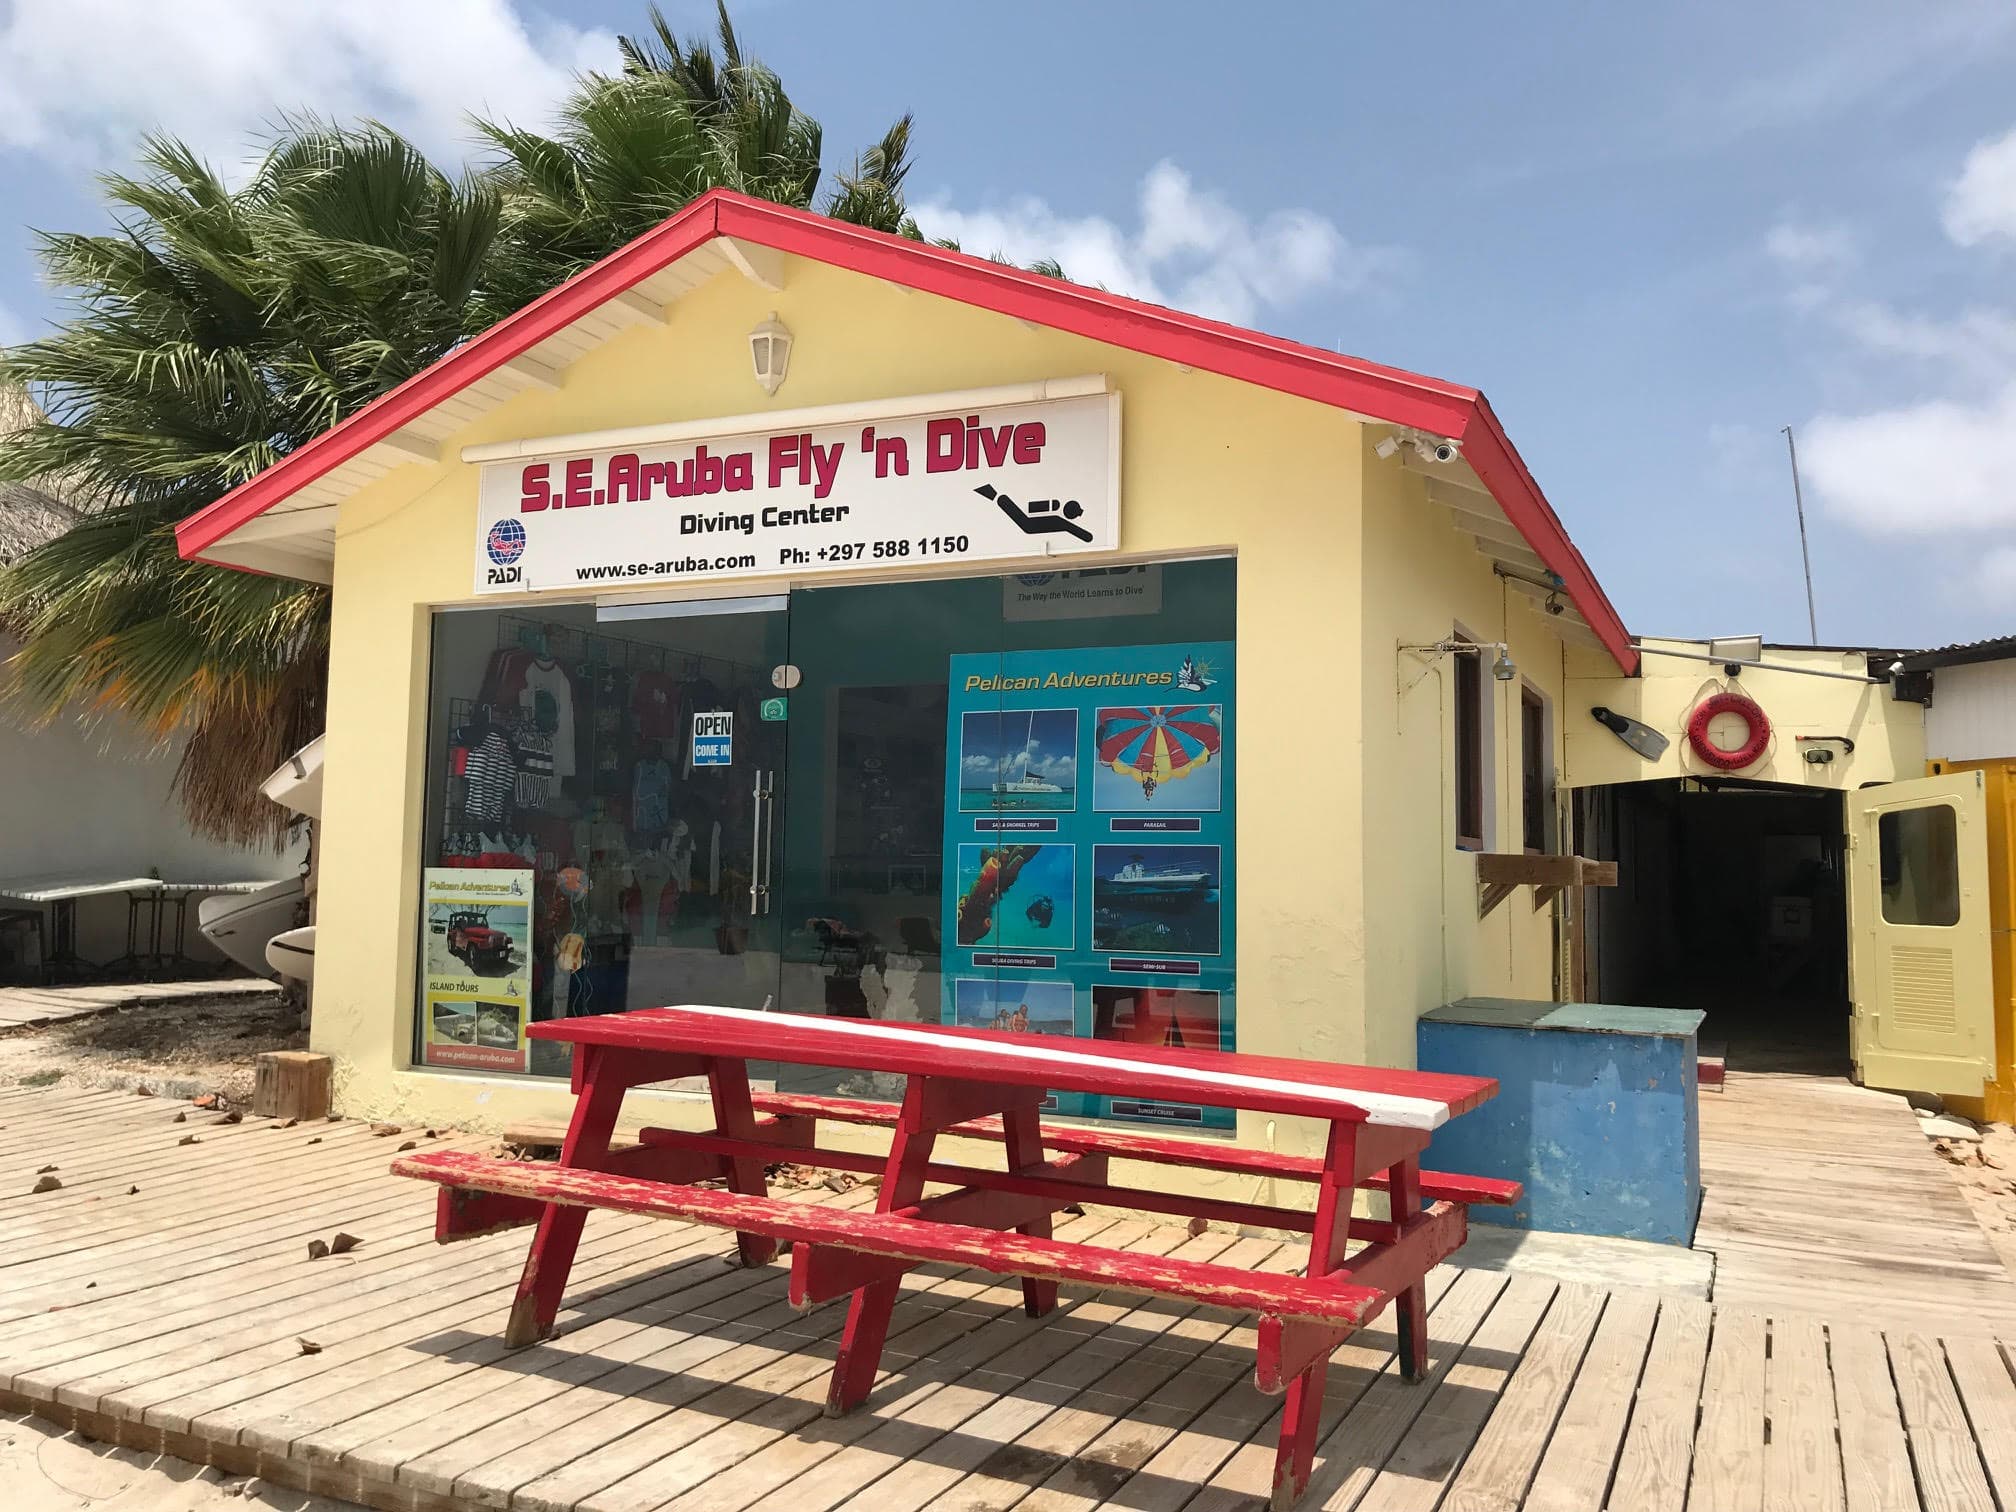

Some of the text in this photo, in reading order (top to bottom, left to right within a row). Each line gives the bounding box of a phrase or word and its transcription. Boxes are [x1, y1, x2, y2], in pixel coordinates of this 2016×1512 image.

[520, 445, 754, 513] S.E.Aruba
[768, 433, 846, 499] Fly
[926, 415, 1047, 474] Dive
[680, 503, 850, 535] Diving Center
[779, 535, 969, 565] Ph: +297 588 1150
[487, 566, 522, 585] PADI
[576, 553, 757, 581] www.se-aruba.com
[1032, 592, 1049, 602] Way
[1049, 590, 1062, 601] the
[1062, 589, 1086, 600] World
[1087, 589, 1115, 599] Learns
[1115, 587, 1125, 597] to
[1125, 585, 1144, 596] Dive
[964, 670, 1174, 693] Pelican Adventures
[695, 716, 731, 736] OPEN
[695, 744, 730, 757] COME IN
[429, 881, 510, 893] Pelican Adventures
[429, 981, 480, 993] ISLAND TOURS
